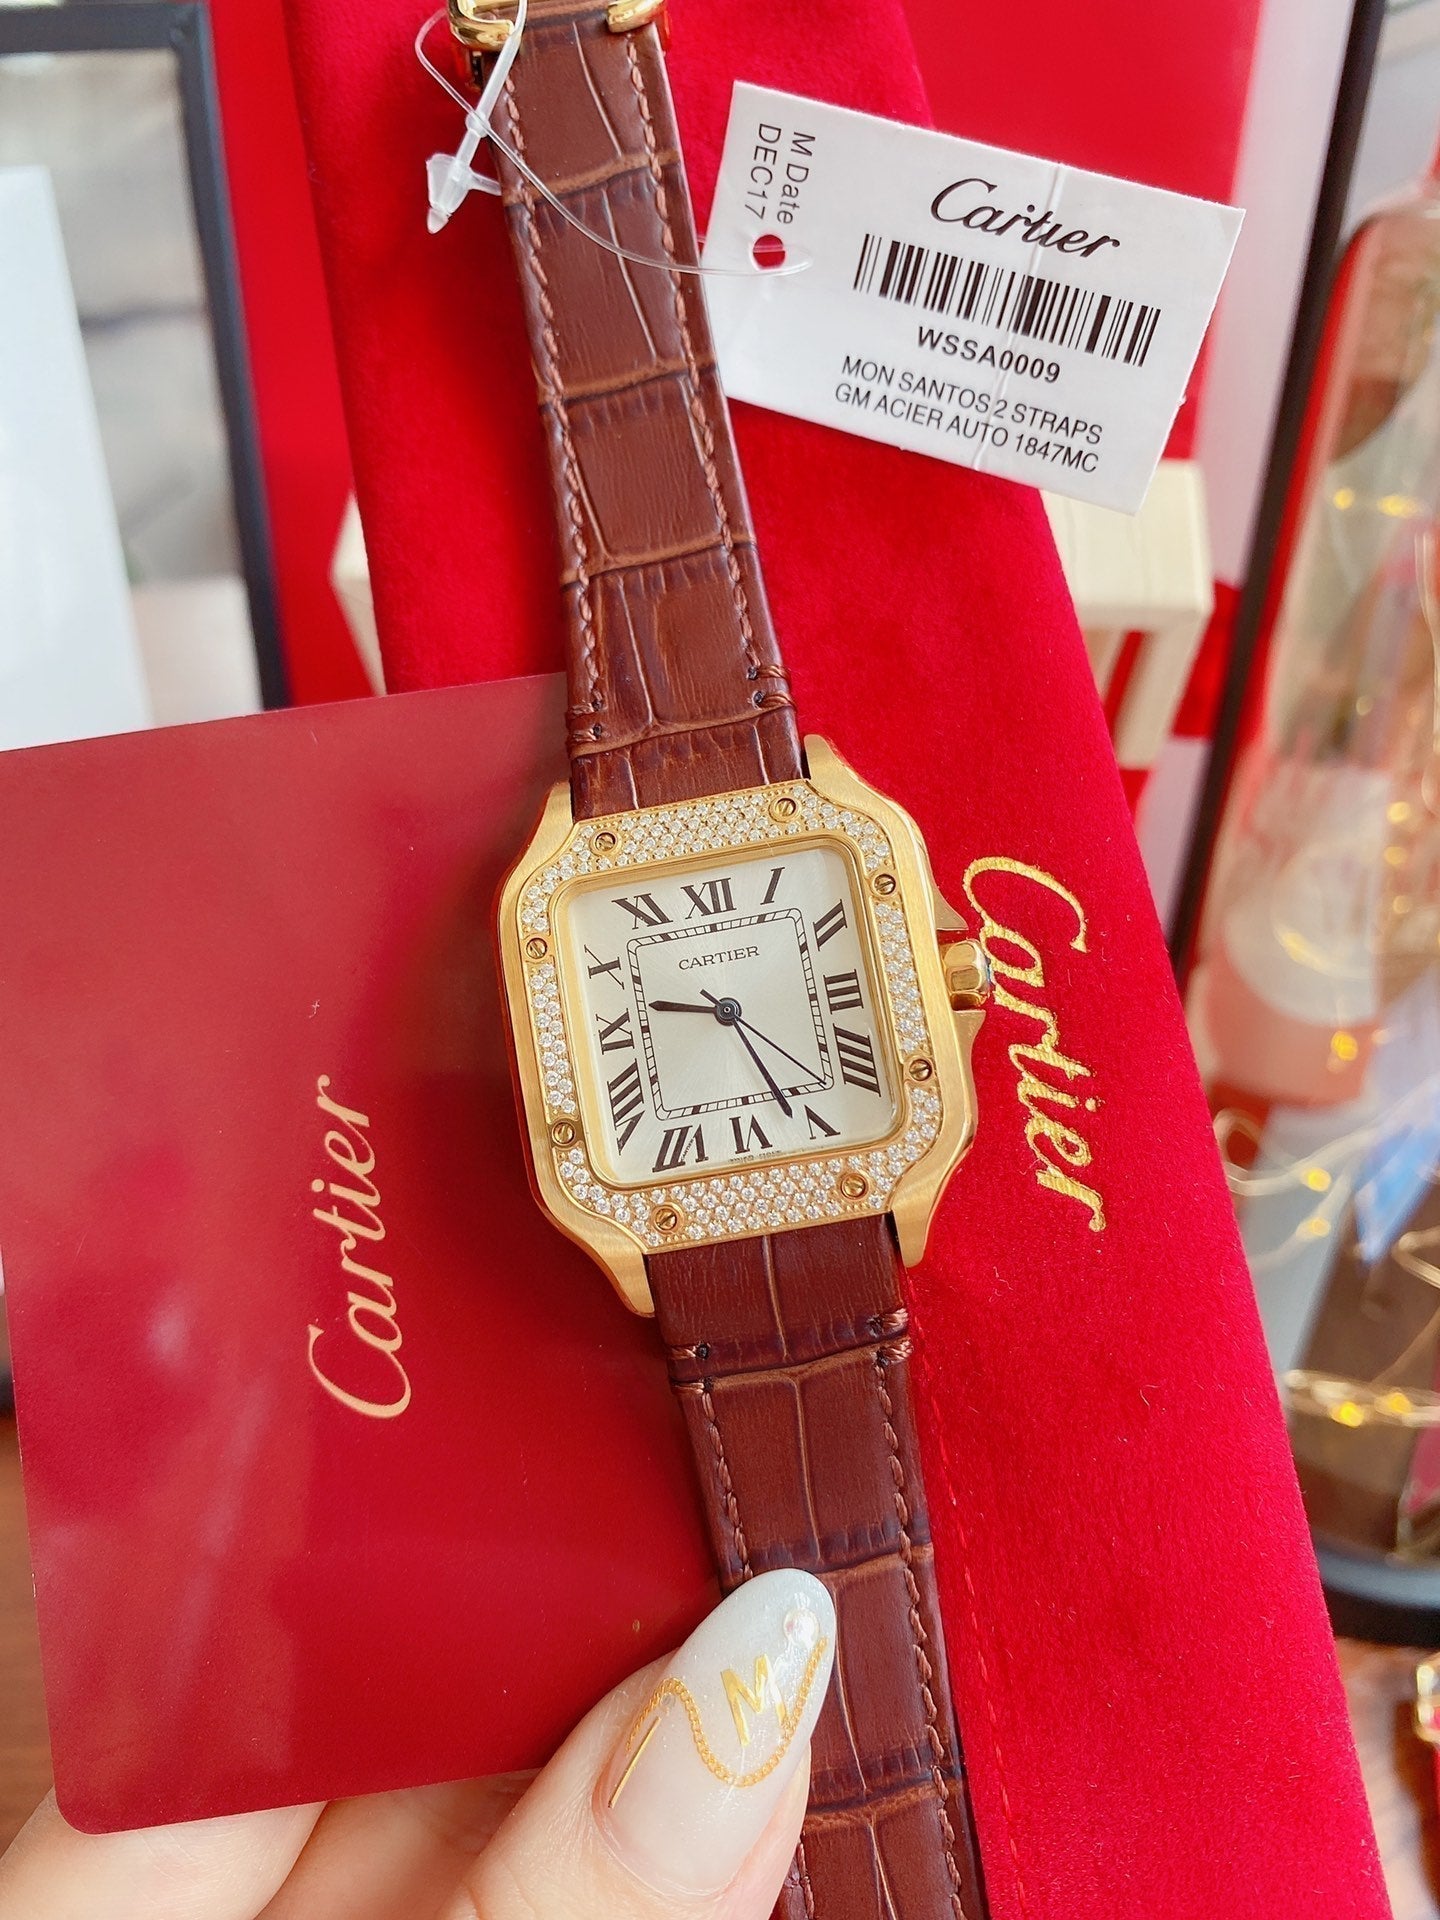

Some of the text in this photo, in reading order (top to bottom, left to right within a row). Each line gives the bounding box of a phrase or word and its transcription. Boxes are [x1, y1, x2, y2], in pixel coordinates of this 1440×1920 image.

[744, 123, 782, 220] DEC17
[777, 131, 816, 225] M Date
[930, 177, 1120, 258] Cartier
[917, 325, 1061, 384] WSSA0009
[841, 355, 1103, 445] MON SANTOS 2 STRAPS
[834, 382, 1100, 473] GM ACIER AUTO 1847MC
[611, 893, 673, 930] XI
[680, 877, 737, 920] XII
[760, 867, 786, 905] I
[813, 899, 849, 951] II
[584, 944, 625, 990] X
[678, 945, 760, 971] CARTIER
[823, 968, 865, 1014] III
[595, 1008, 635, 1056] IX
[962, 856, 1107, 1233] Cartier
[728, 1114, 773, 1155] VI
[804, 1104, 841, 1140] V
[308, 1074, 412, 1419] Cartier
[720, 1653, 788, 1747] M
